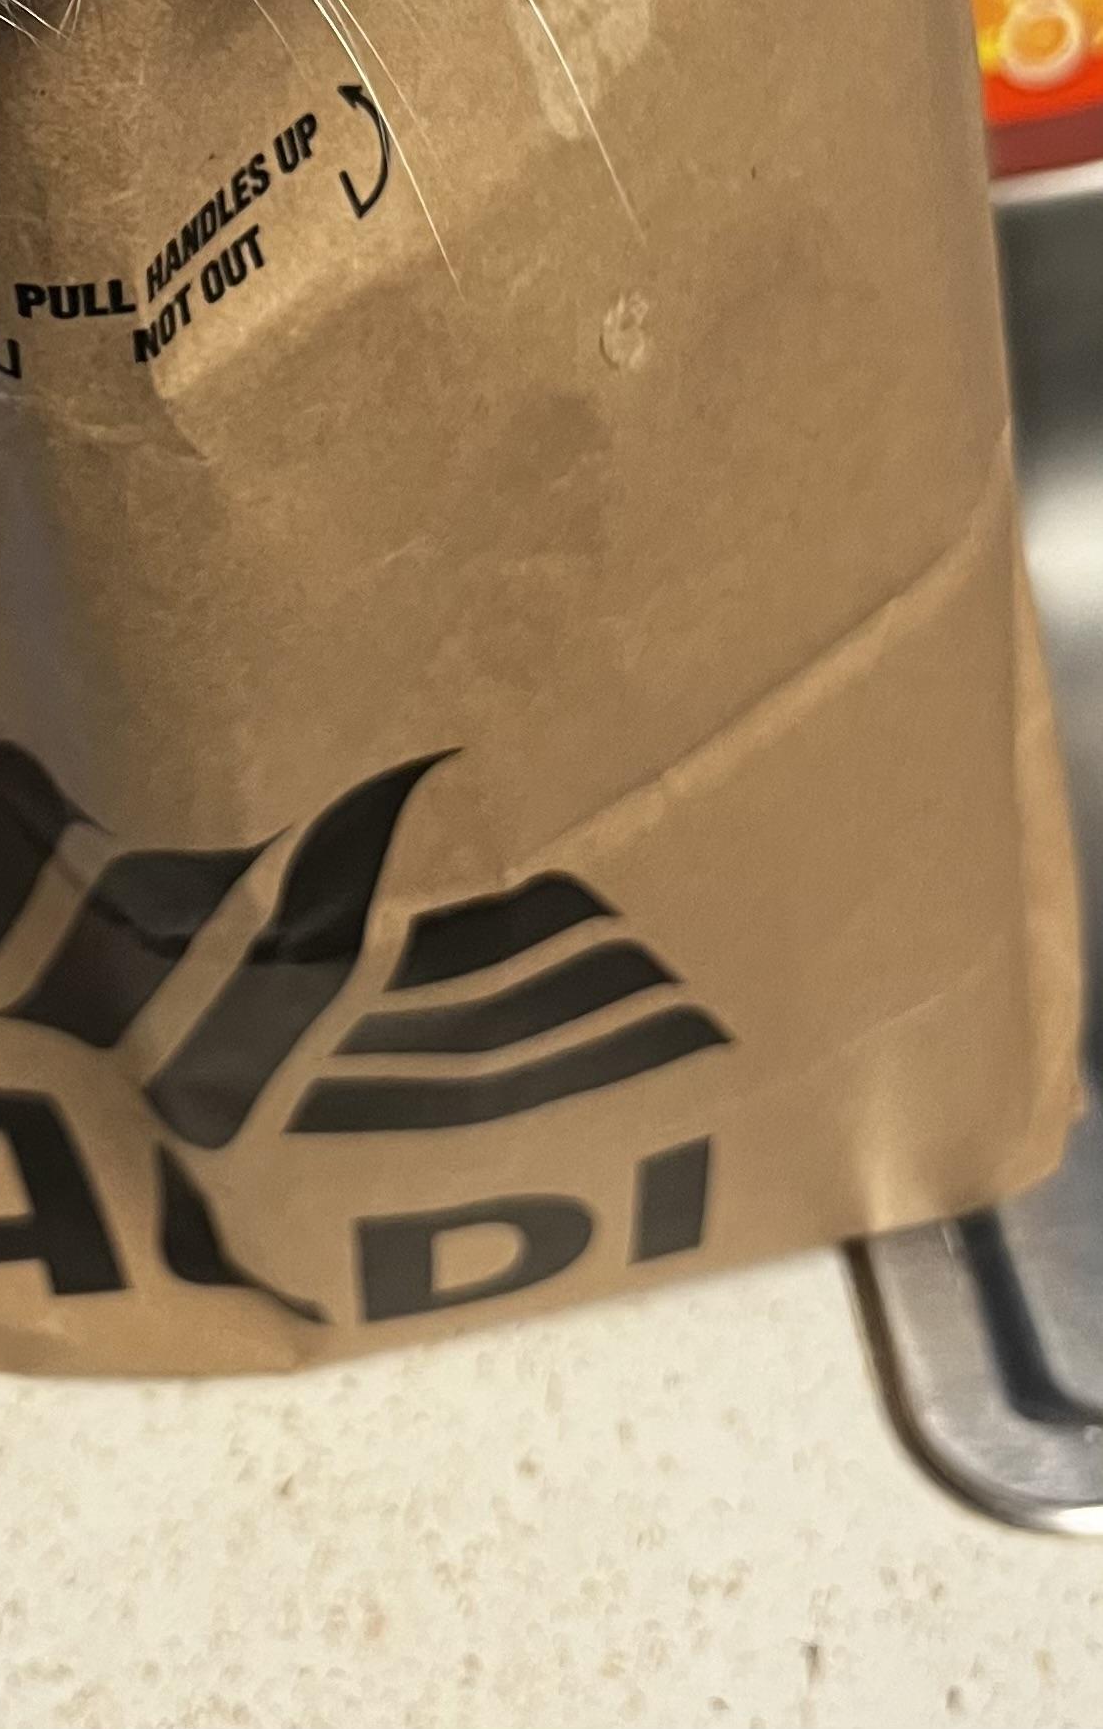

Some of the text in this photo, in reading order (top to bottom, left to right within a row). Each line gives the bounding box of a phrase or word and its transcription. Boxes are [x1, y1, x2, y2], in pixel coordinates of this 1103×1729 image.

[15, 112, 317, 319] PULL HANDLES UP
[133, 224, 266, 364] NOT OUT
